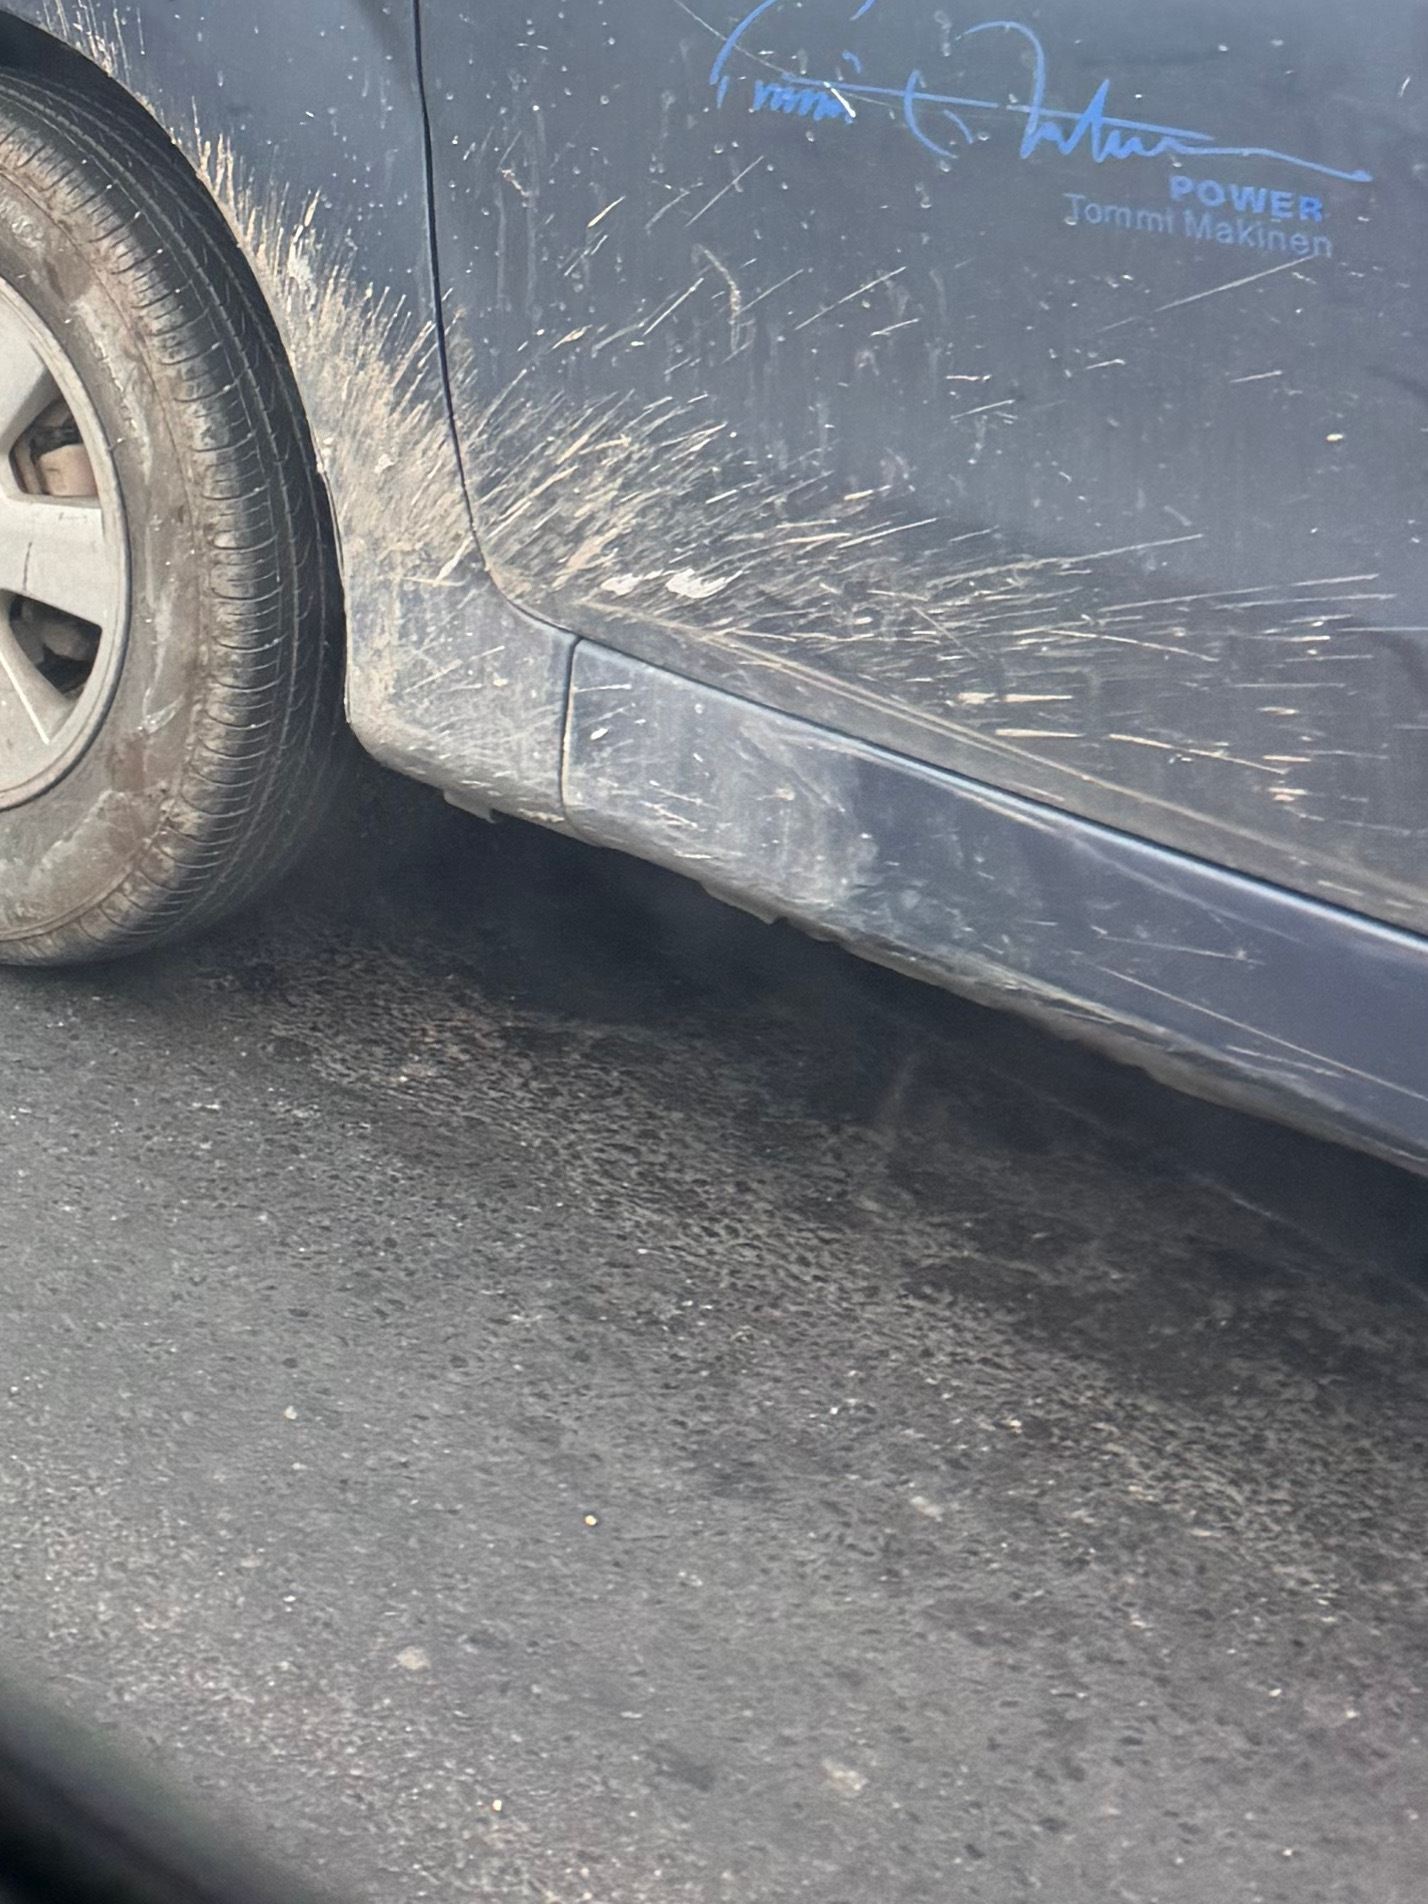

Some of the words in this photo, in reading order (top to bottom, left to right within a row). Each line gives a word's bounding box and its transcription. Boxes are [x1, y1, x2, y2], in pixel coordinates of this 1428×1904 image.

[1063, 192, 1174, 235] Tommi
[1183, 208, 1334, 258] Makinen
[1168, 174, 1323, 222] POWER
